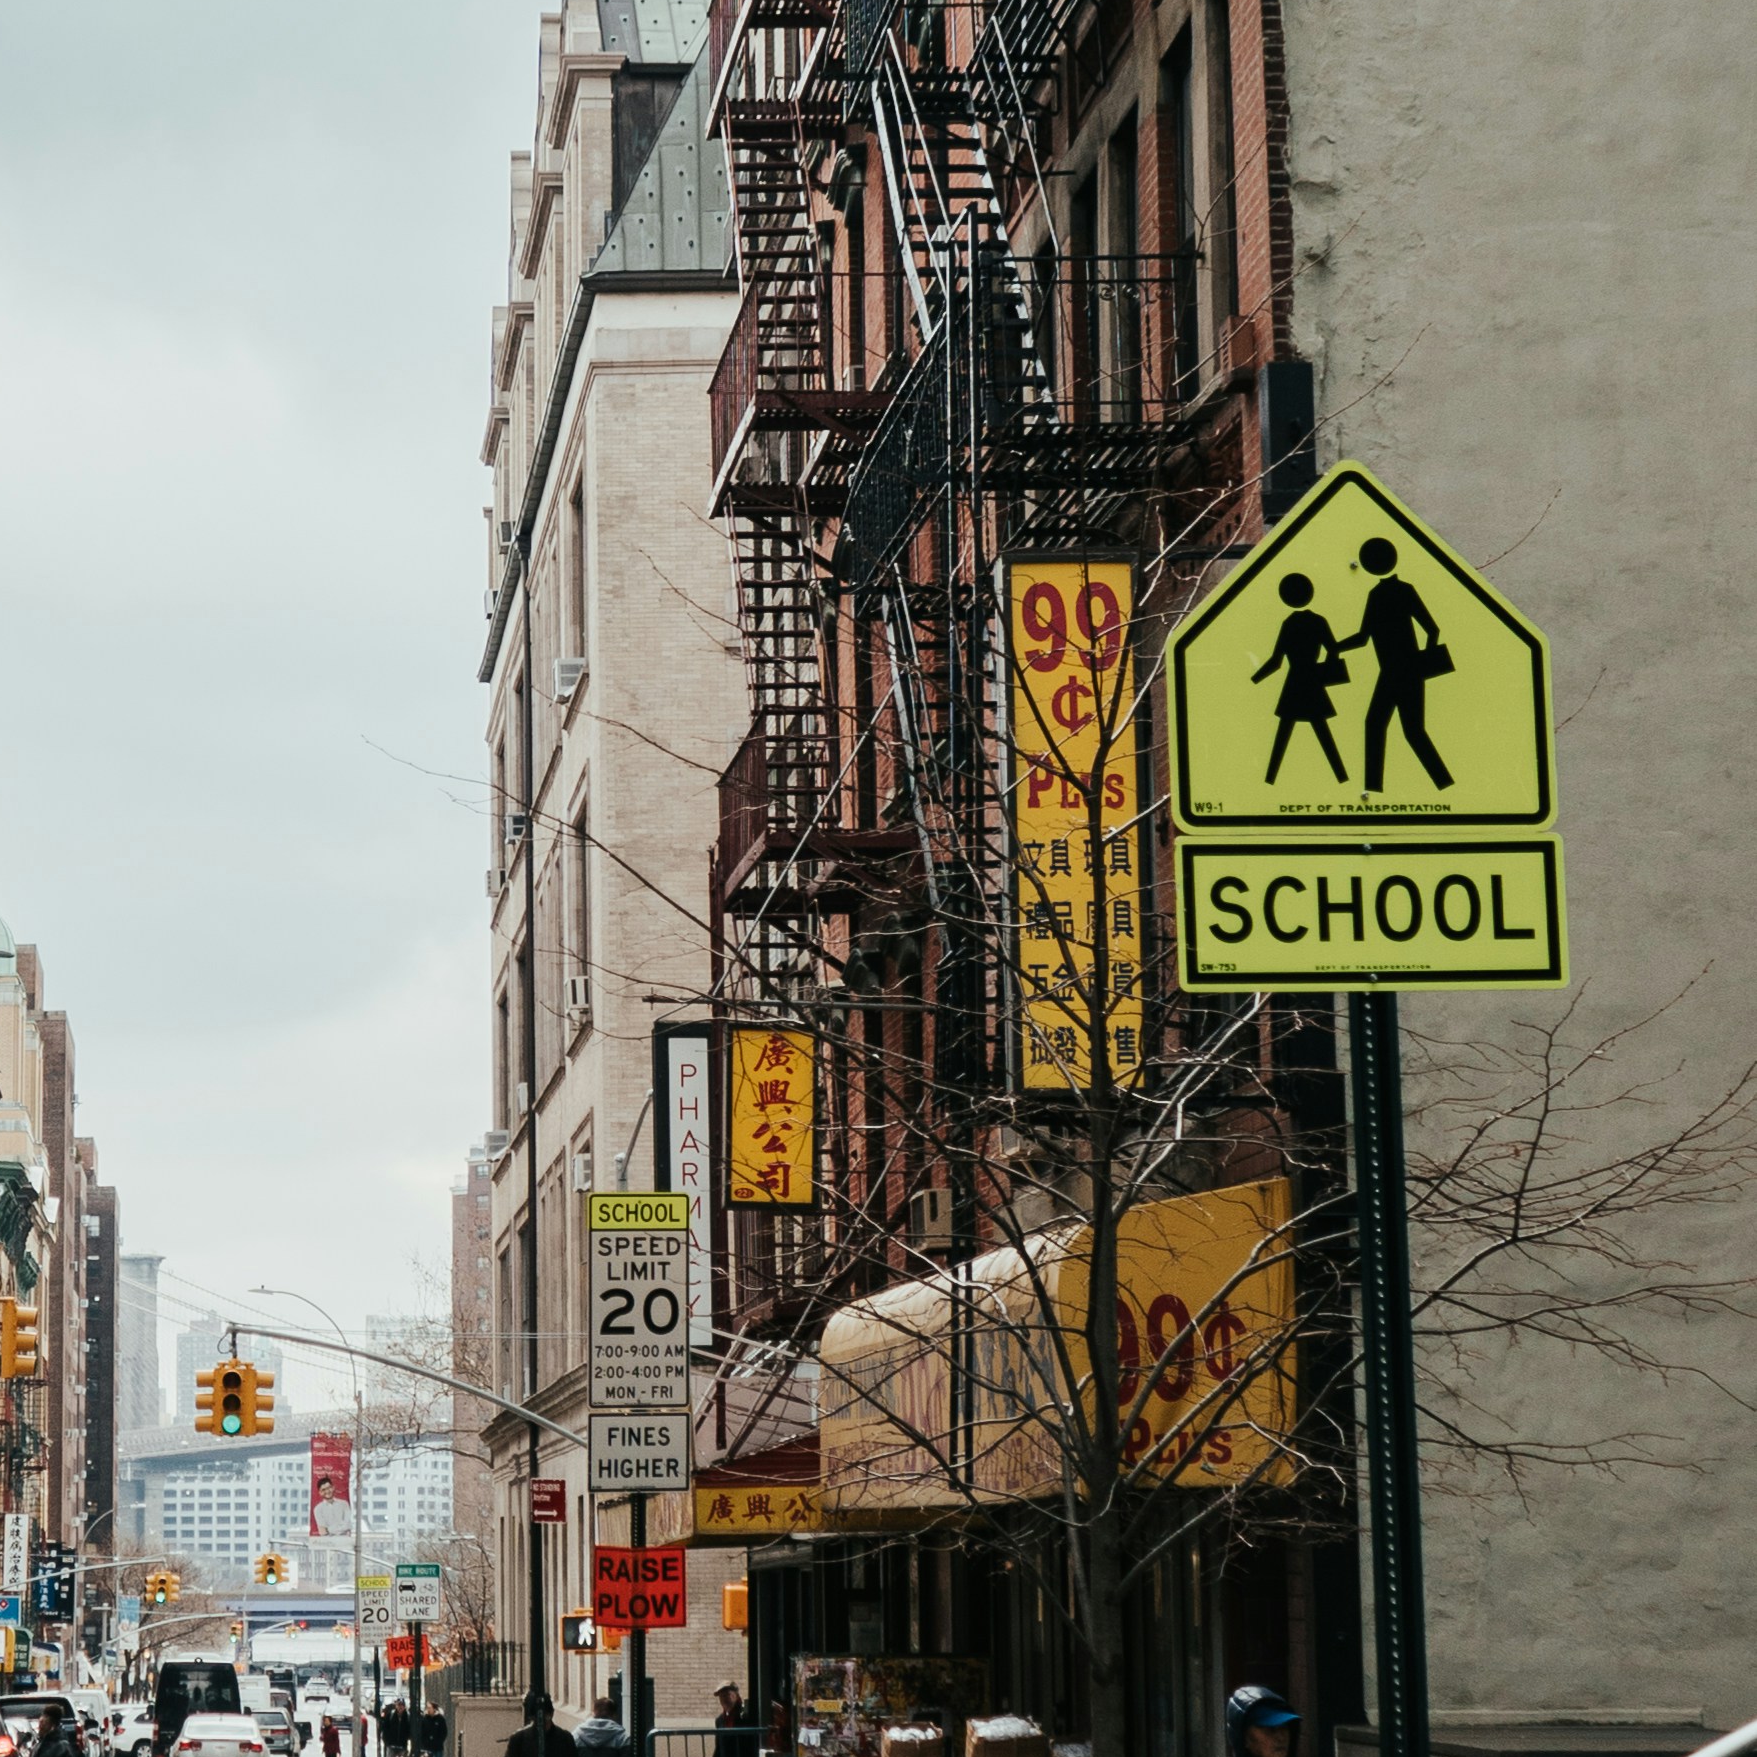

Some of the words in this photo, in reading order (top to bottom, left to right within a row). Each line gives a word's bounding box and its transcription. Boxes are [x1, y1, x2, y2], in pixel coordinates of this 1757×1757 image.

[1022, 582, 1122, 673] 99
[1195, 802, 1223, 813] W9-1
[1279, 805, 1311, 813] DEPT
[1317, 805, 1333, 813] OF
[1338, 804, 1451, 813] TRANSPORTATION
[1023, 839, 1072, 878] 文具
[1208, 874, 1536, 944] SCHOOL
[1087, 900, 1135, 940] 具
[1200, 963, 1237, 973] SW-753
[752, 1034, 795, 1199] 廣興公司
[598, 1203, 680, 1223] SCHOOL
[598, 1237, 681, 1256] SPEED
[607, 1261, 670, 1280] LIMIT
[600, 1288, 679, 1335] 20
[595, 1345, 660, 1358] 7:00-9:00
[664, 1345, 685, 1357] AM
[595, 1365, 661, 1379] 2:00-4:00
[665, 1366, 685, 1377] PM
[605, 1386, 636, 1398] MON
[651, 1385, 674, 1398] FRI
[607, 1427, 671, 1447] FINES
[598, 1458, 680, 1479] HIGHER
[598, 1557, 680, 1583] RAISE
[361, 1579, 388, 1587] SCHOOL
[360, 1590, 389, 1598] SPEED
[399, 1596, 437, 1605] SHARED
[362, 1607, 390, 1623] 20
[405, 1607, 431, 1616] LANE
[598, 1592, 680, 1620] PLOW
[393, 1654, 425, 1668] PLO
